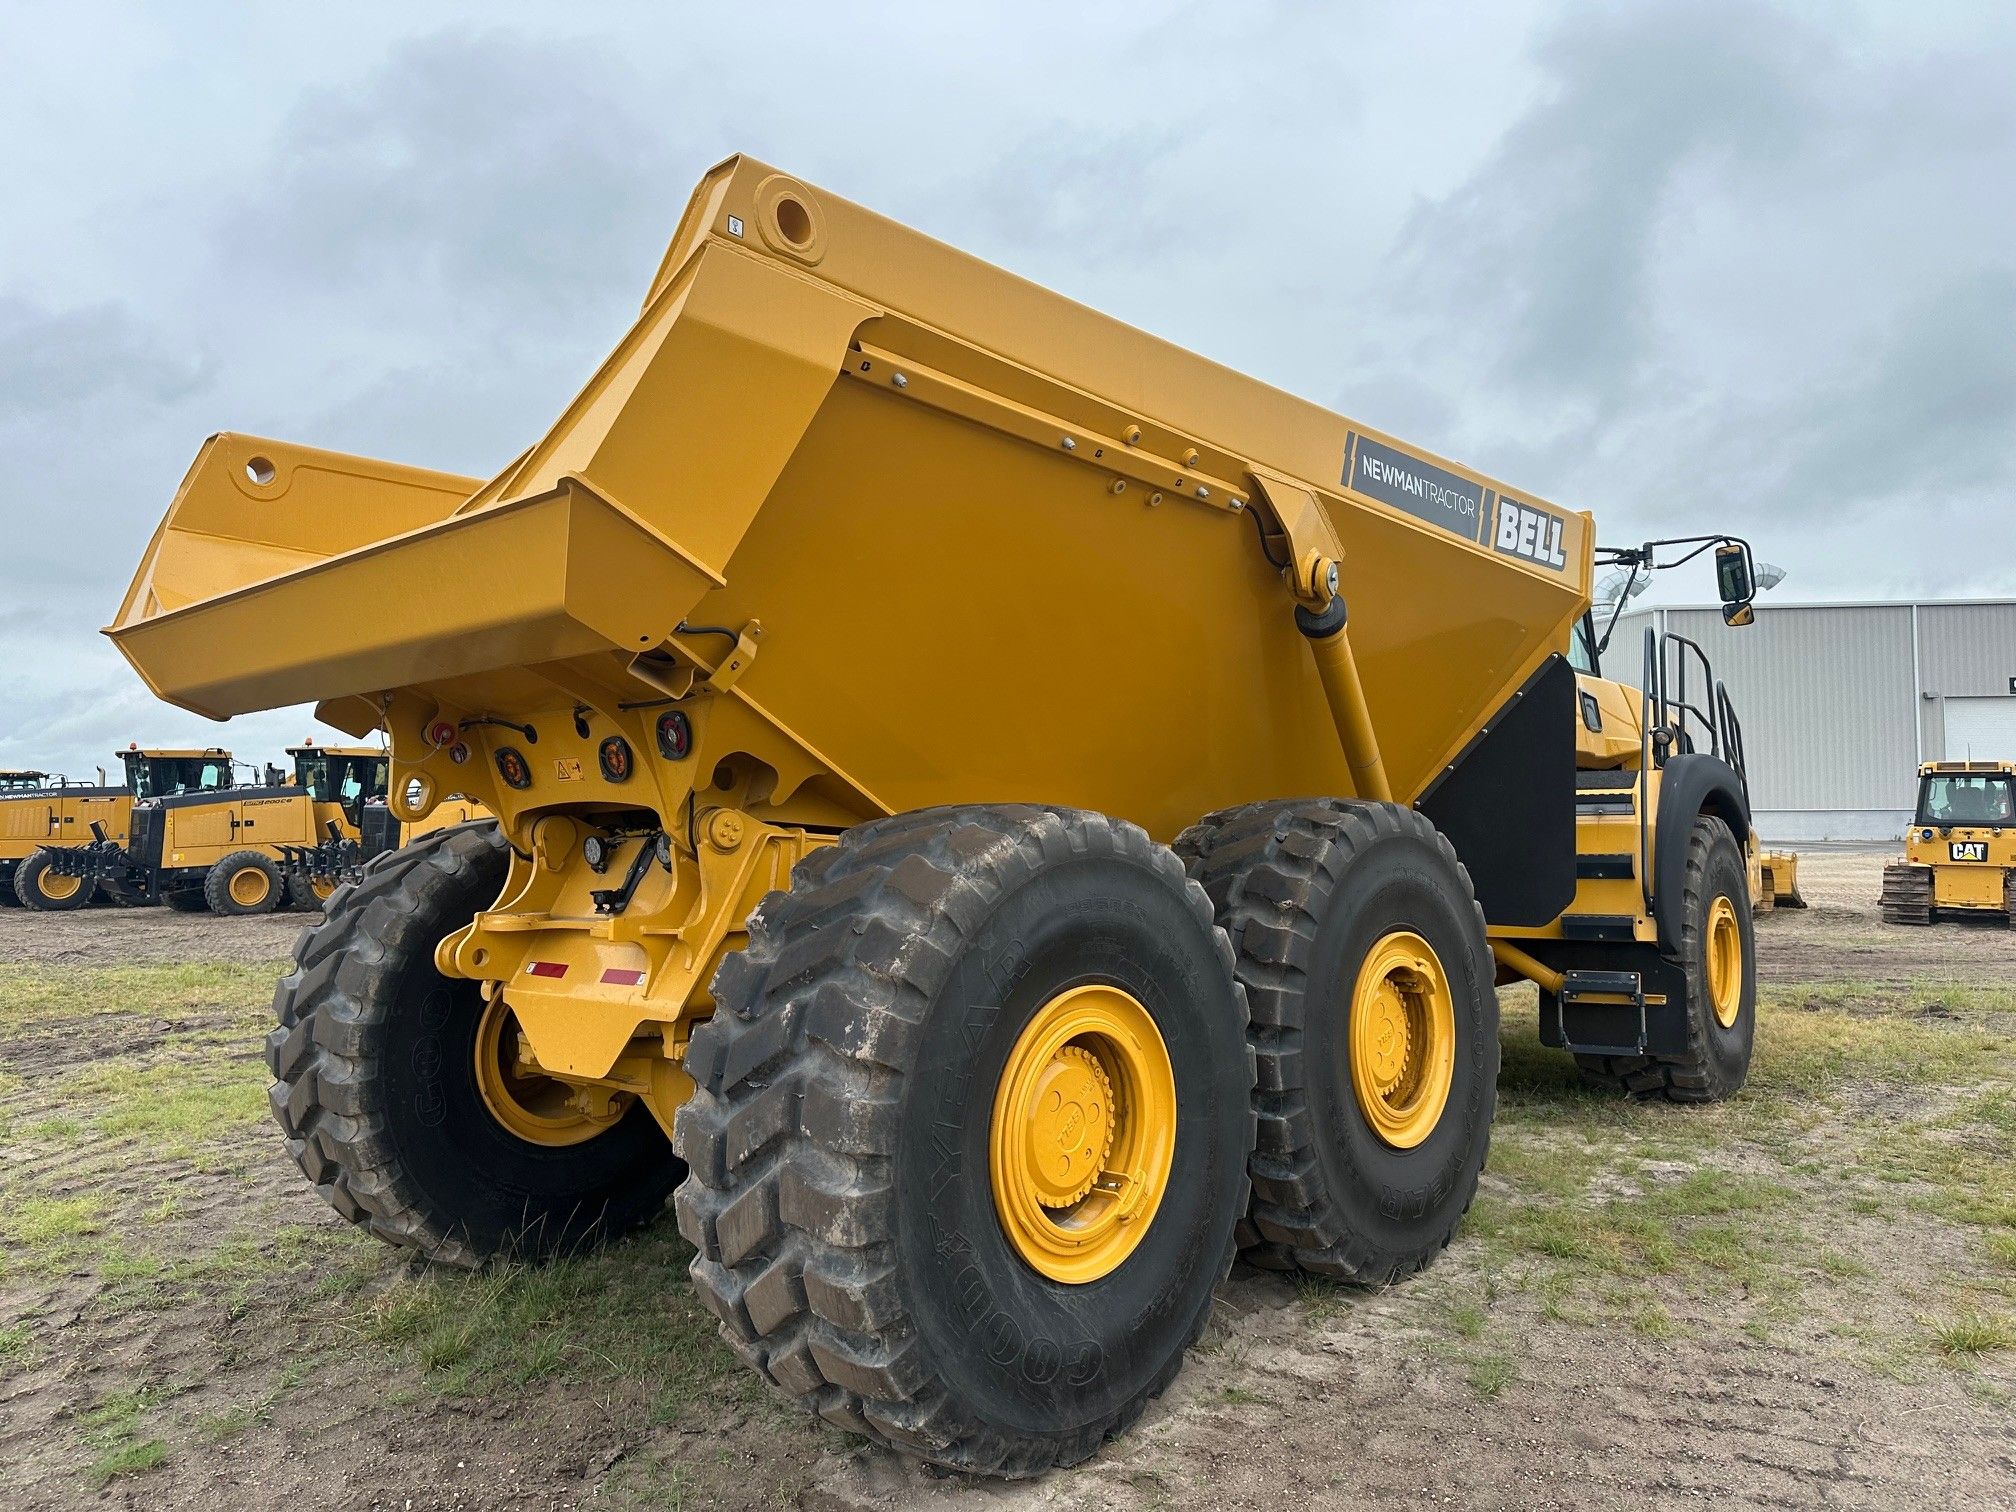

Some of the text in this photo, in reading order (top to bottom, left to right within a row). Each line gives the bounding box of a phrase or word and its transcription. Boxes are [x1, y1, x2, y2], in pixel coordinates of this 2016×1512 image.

[1362, 455, 1475, 518] NEWMANTRACTOR
[1497, 501, 1565, 567] BELL
[1952, 843, 1985, 861] CAT
